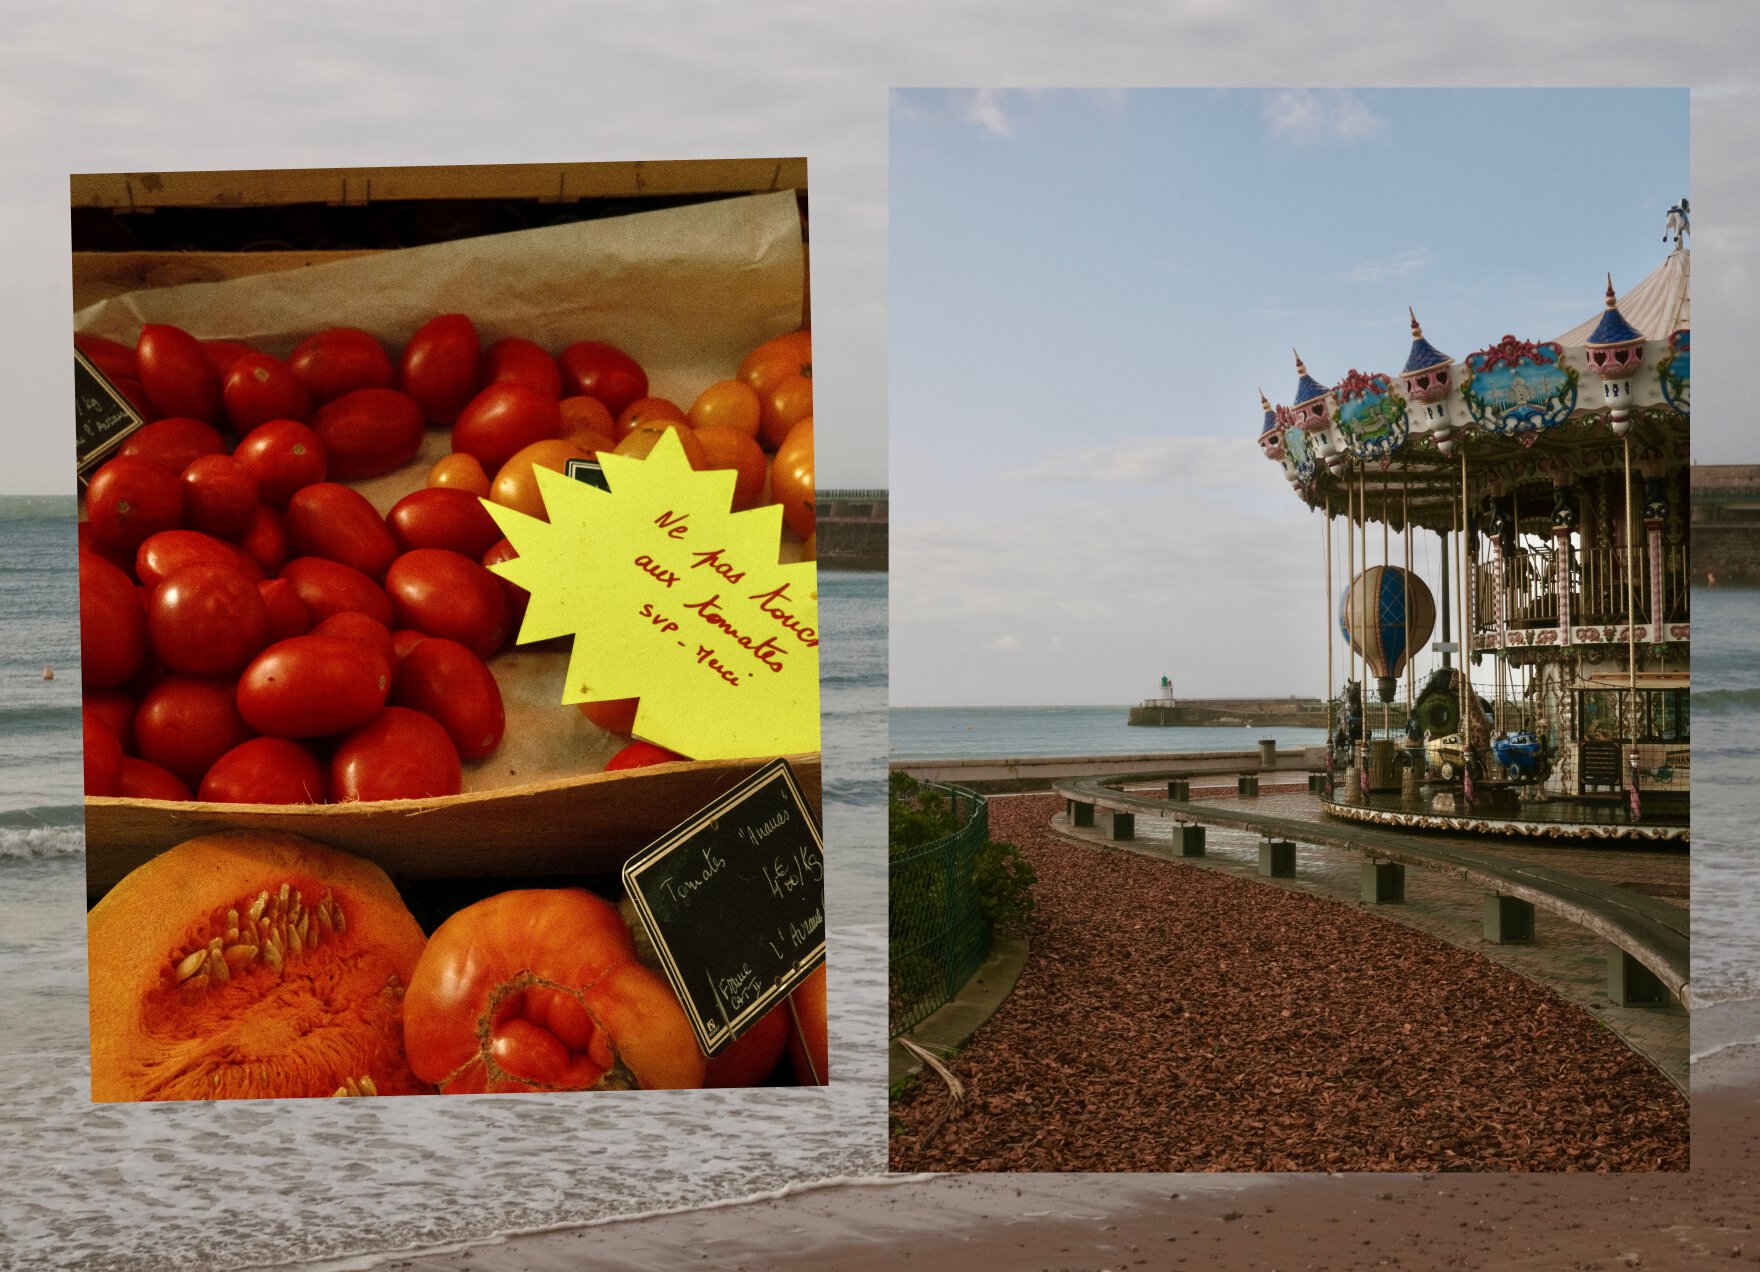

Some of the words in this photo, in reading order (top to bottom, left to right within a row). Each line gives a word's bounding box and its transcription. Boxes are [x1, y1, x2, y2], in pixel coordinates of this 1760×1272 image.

[654, 510, 689, 539] Ne
[691, 549, 746, 584] pas
[635, 555, 680, 588] aux
[683, 595, 788, 672] tomates
[660, 847, 726, 901] Tomates
